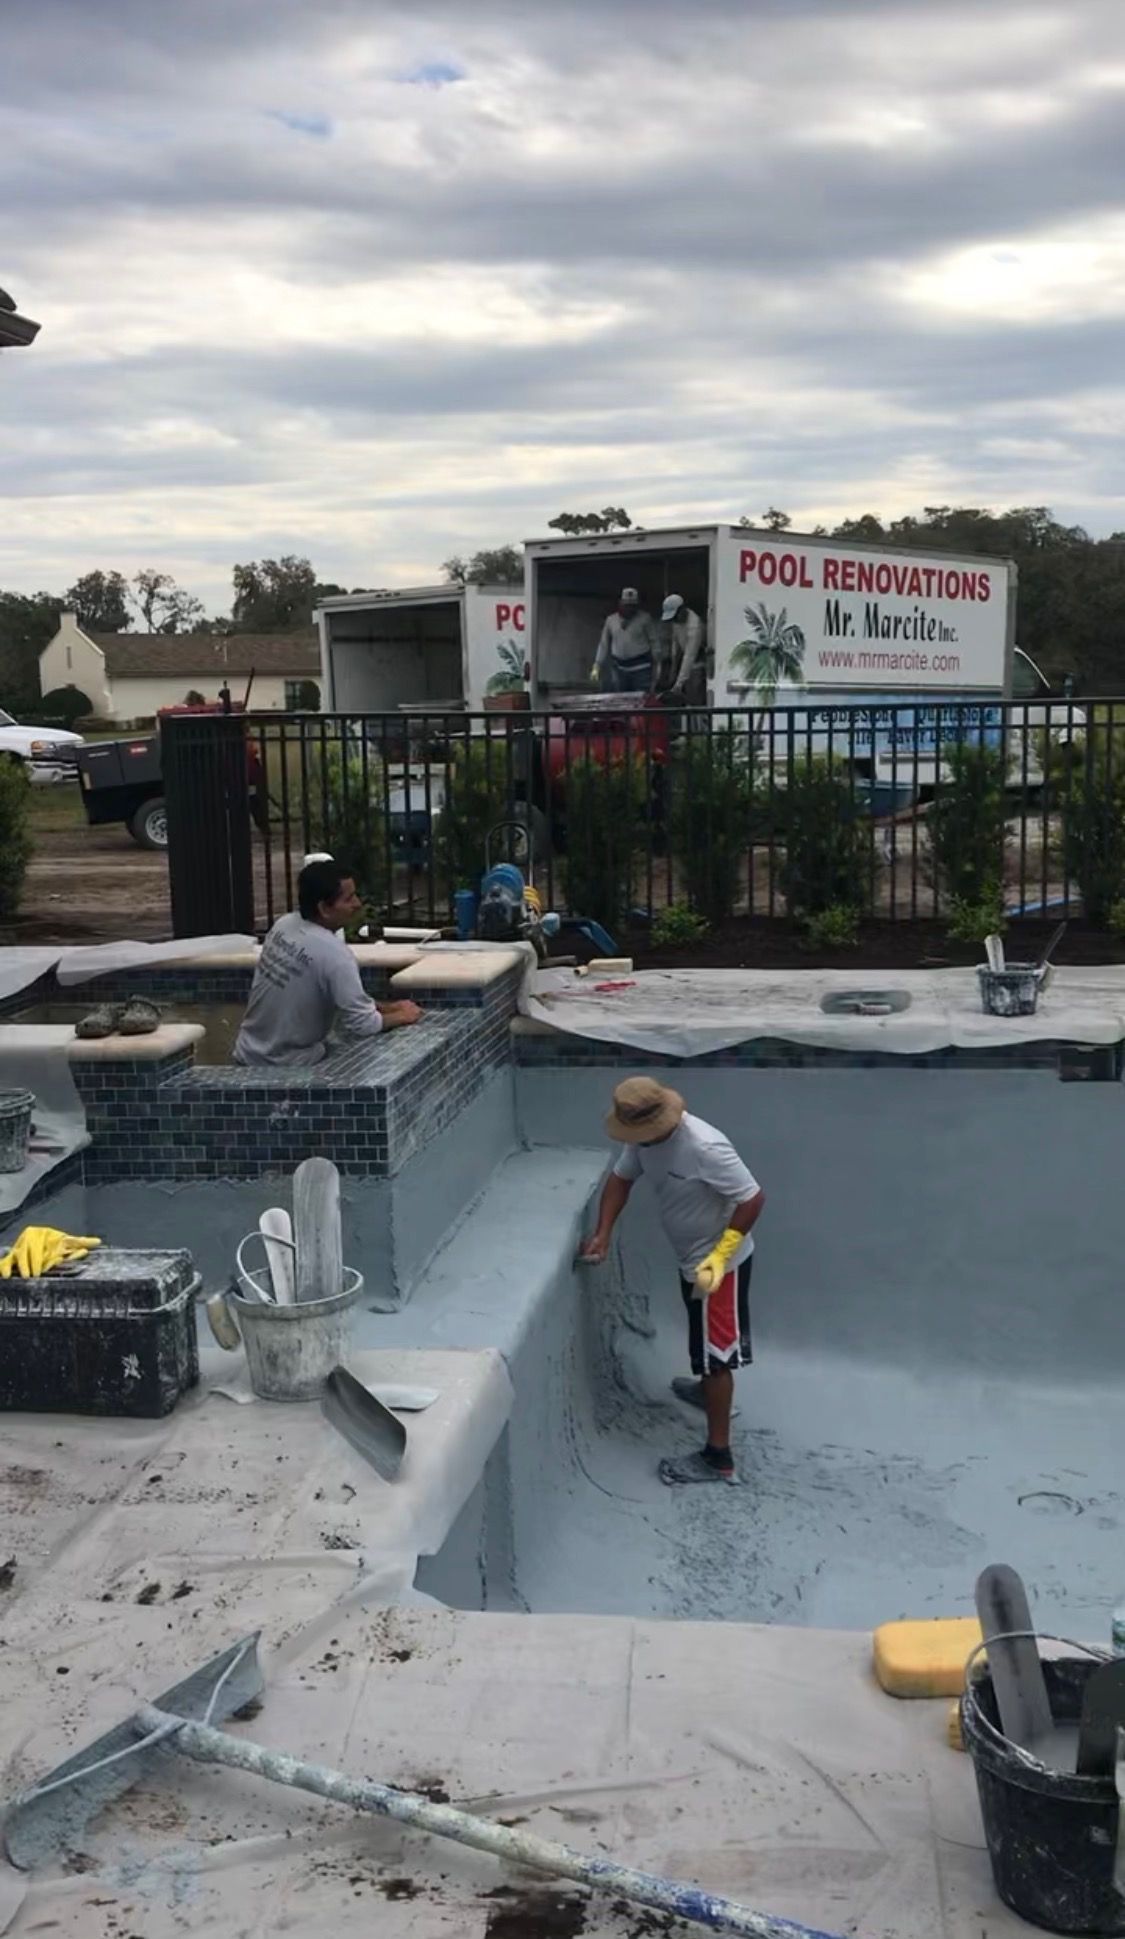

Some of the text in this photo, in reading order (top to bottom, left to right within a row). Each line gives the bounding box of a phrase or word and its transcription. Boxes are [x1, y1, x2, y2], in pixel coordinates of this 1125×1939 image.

[739, 549, 991, 602] POOL RENOVATIONS
[823, 598, 959, 642] Mr. Marcite Inc.
[818, 649, 960, 673] www.mrmarcite.com
